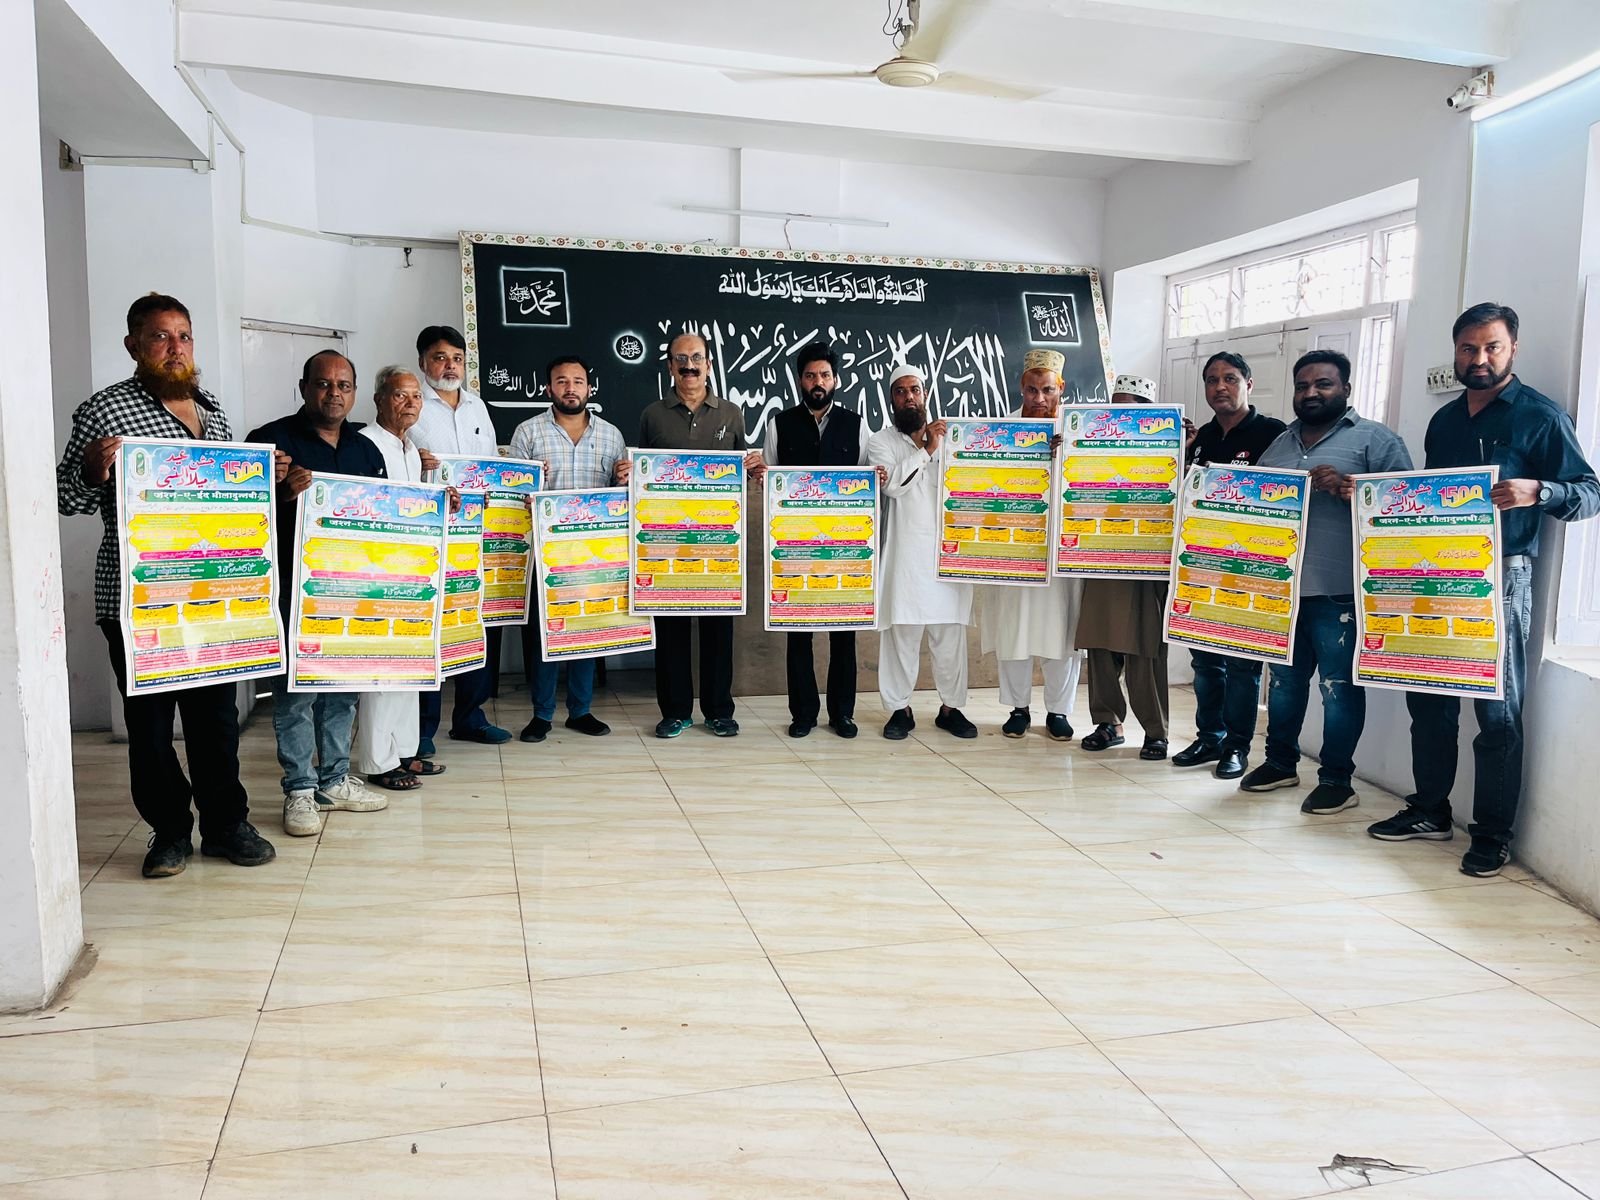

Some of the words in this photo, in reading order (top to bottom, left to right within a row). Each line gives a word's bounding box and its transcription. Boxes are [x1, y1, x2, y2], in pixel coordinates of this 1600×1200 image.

[1137, 416, 1176, 435] 1500
[1013, 431, 1048, 448] 1500
[221, 460, 264, 484] 1500
[501, 471, 534, 487] 1500
[703, 464, 737, 480] 1500
[836, 479, 870, 495] 1500
[1259, 483, 1299, 503] 1500
[1438, 485, 1486, 509] 1500
[396, 497, 439, 518] 1500
